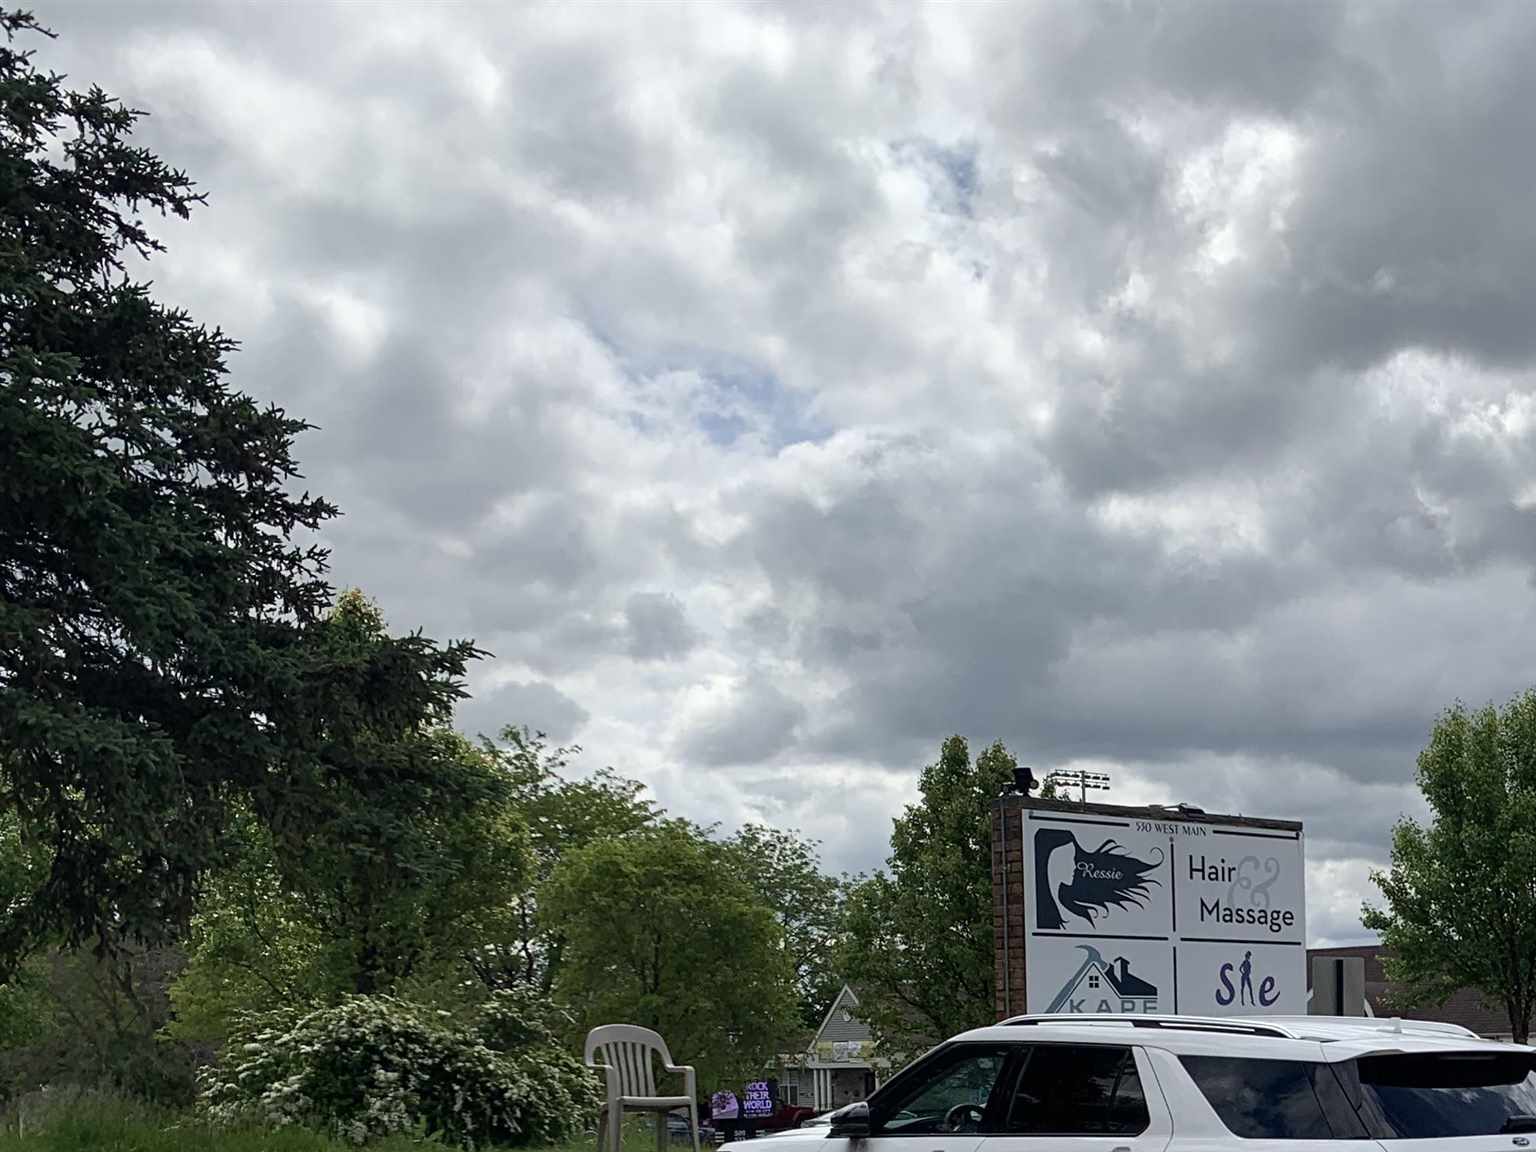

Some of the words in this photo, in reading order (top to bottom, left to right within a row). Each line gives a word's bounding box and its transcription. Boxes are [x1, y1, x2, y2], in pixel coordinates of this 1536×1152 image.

[1154, 823, 1179, 834] WEST
[1182, 825, 1207, 836] MAIN
[1189, 855, 1236, 882] Hair
[1200, 898, 1294, 933] Massage
[743, 1100, 772, 1110] WORLD
